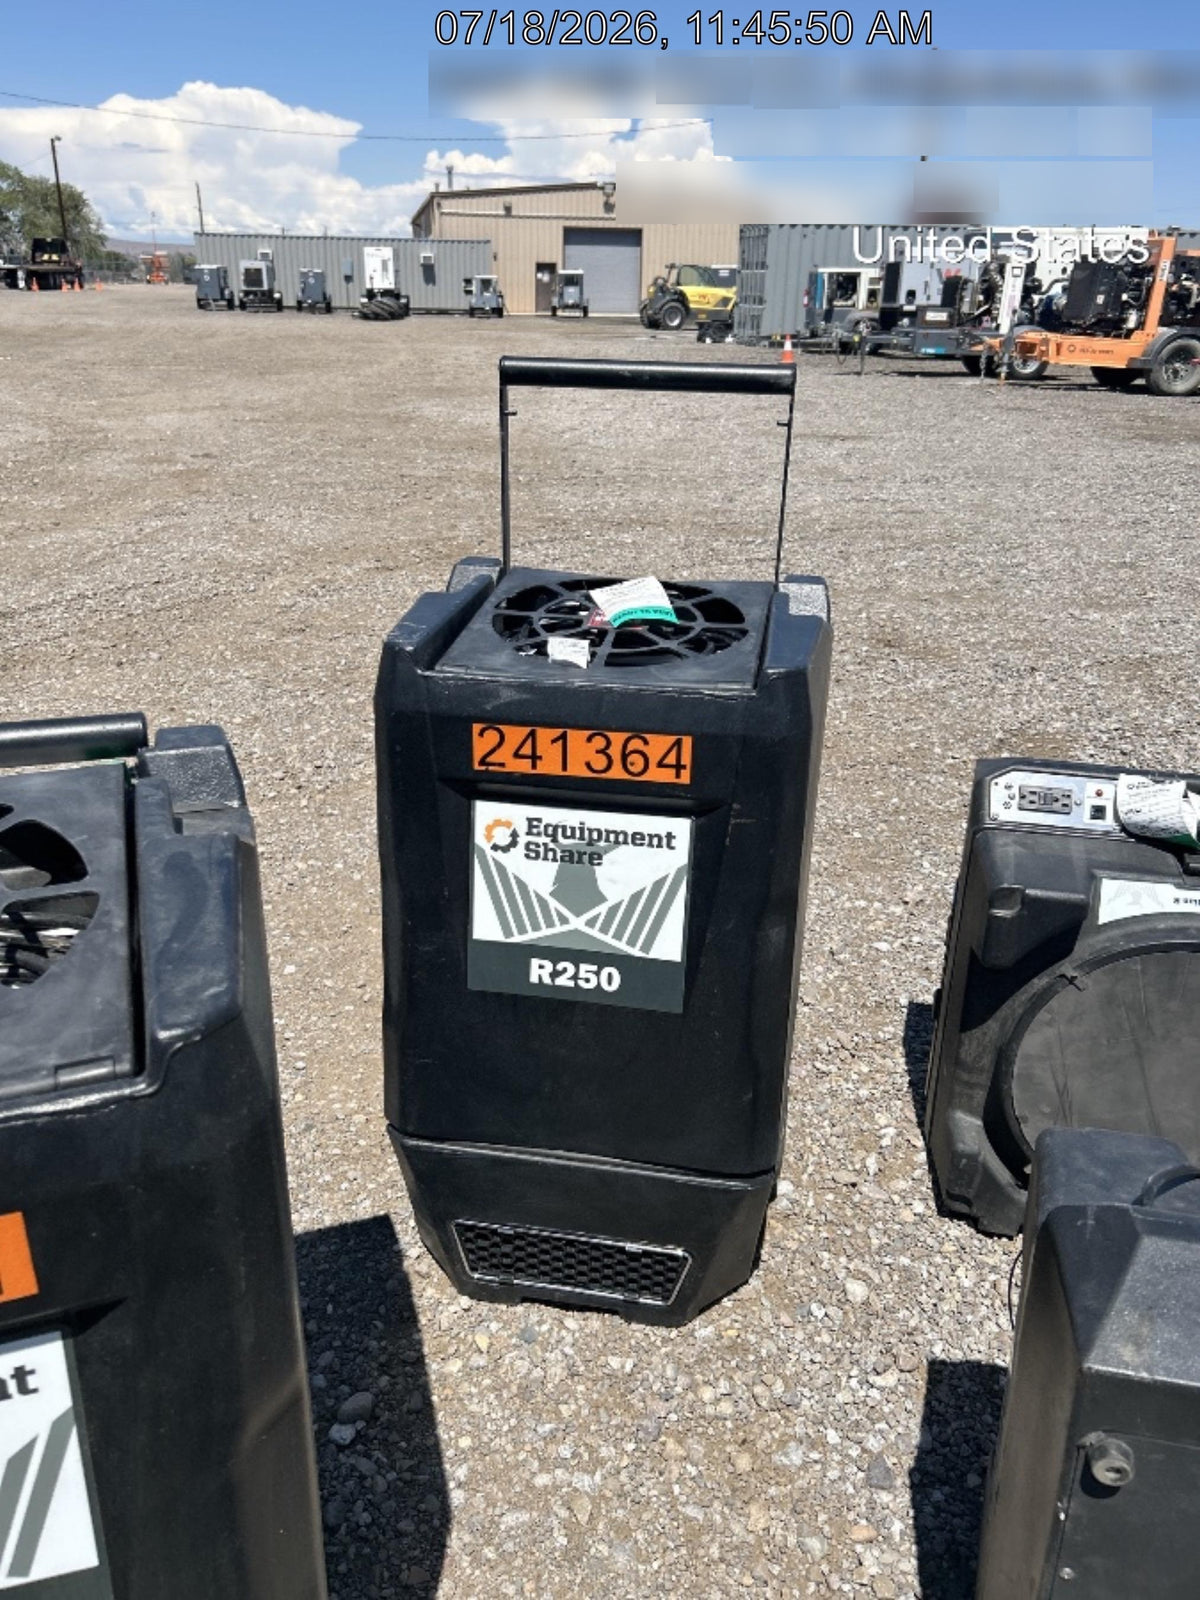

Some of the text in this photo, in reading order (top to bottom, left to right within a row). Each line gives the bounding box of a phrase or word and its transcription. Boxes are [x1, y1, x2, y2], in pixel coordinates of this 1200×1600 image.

[477, 725, 688, 779] 241364
[525, 816, 677, 851] Equipment
[523, 840, 604, 867] Share
[529, 957, 622, 993] R250
